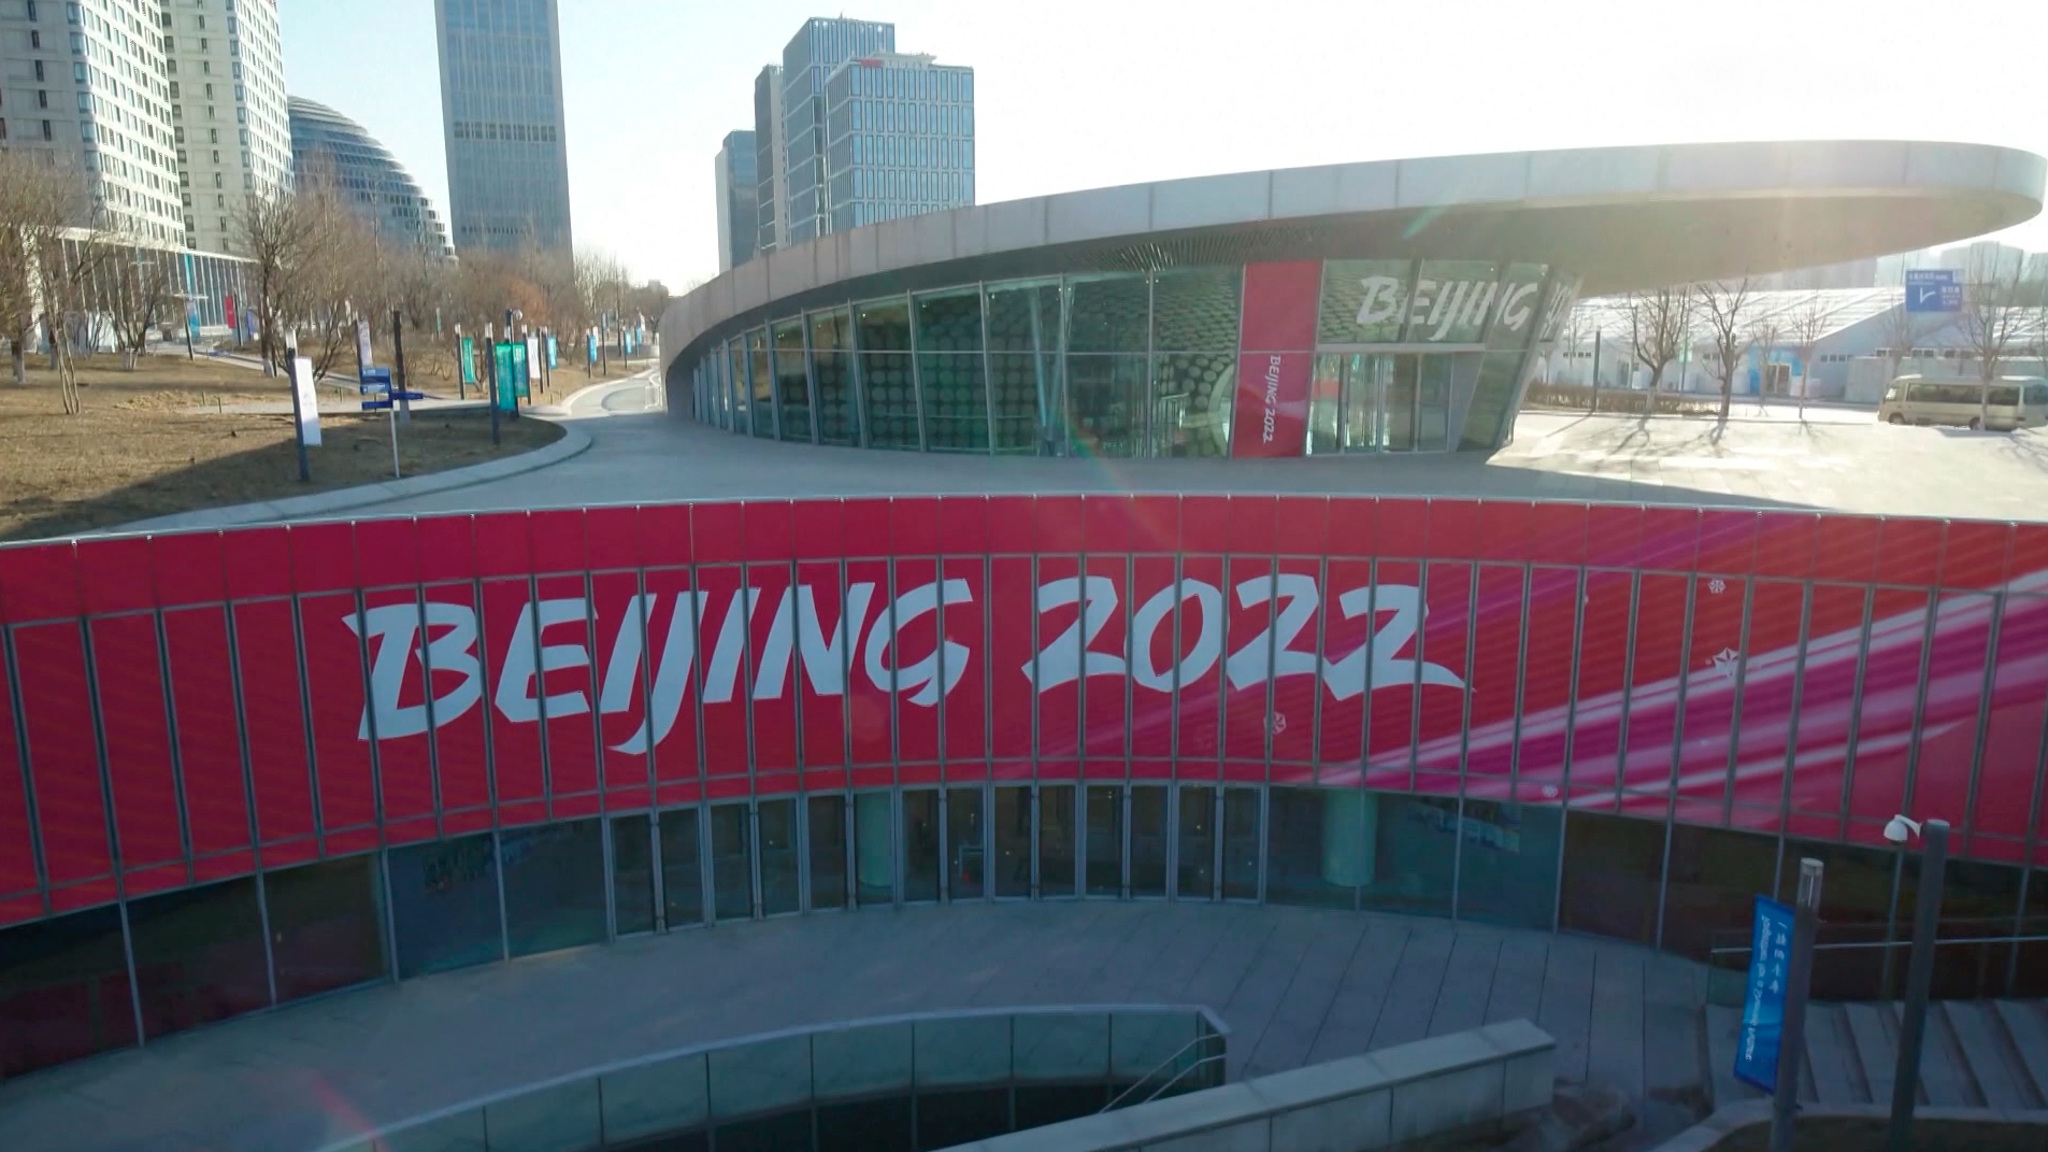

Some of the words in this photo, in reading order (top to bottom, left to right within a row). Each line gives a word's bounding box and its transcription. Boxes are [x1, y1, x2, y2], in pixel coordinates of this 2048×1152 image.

[1356, 276, 1537, 342] BEIJING
[1265, 355, 1281, 406] BEIJING
[1263, 408, 1275, 443] 2022
[342, 578, 973, 755] BEIJING
[1021, 574, 1476, 701] 2022
